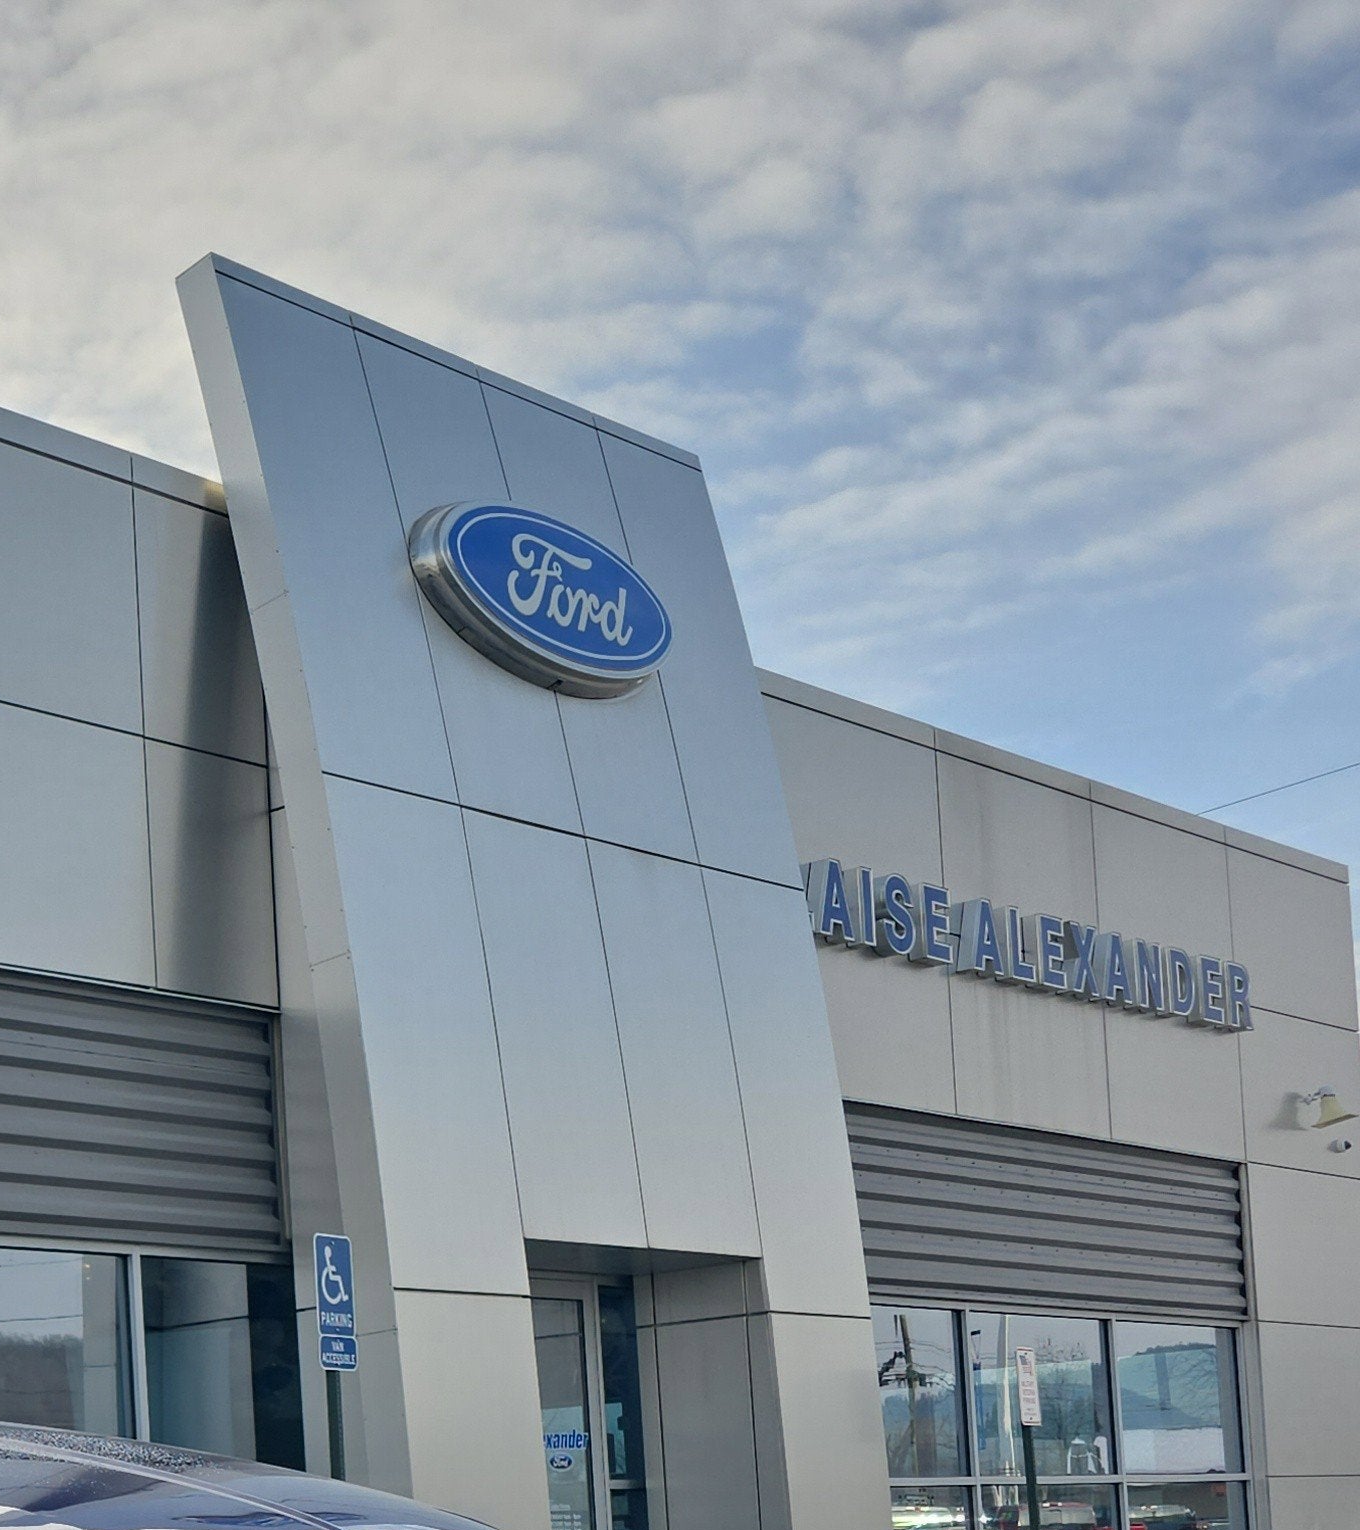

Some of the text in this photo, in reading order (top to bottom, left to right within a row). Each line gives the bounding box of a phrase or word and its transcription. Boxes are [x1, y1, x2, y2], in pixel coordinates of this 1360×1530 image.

[507, 532, 634, 646] Ford
[808, 857, 1254, 1031] AISE ALEXANDER
[320, 1311, 352, 1328] PARKING
